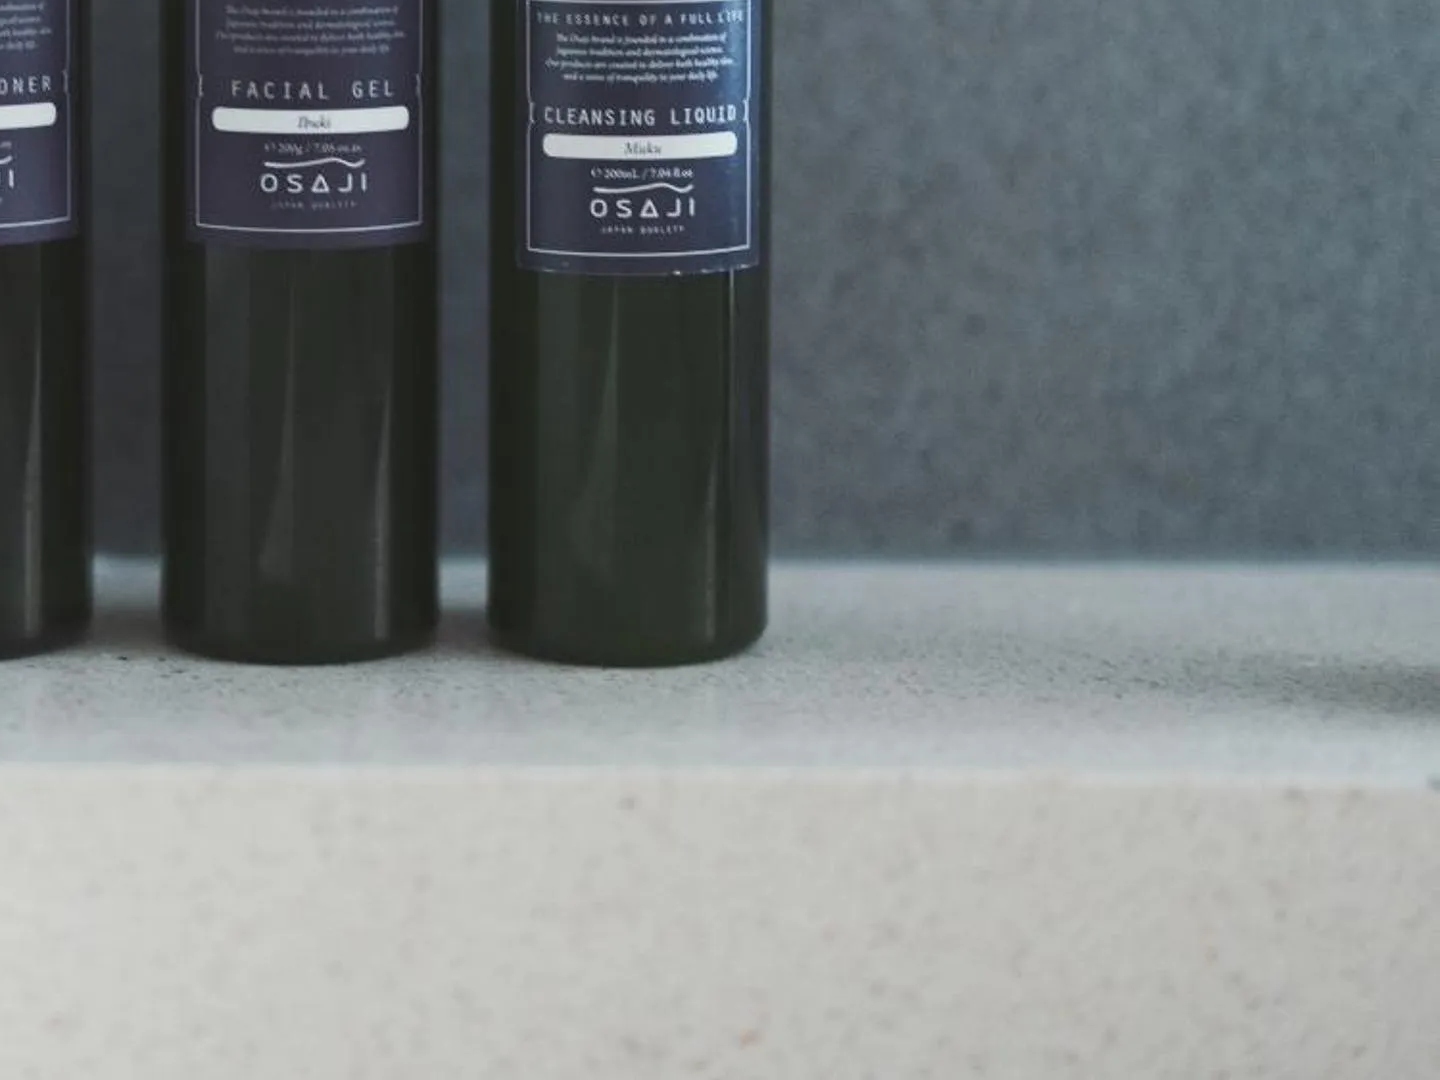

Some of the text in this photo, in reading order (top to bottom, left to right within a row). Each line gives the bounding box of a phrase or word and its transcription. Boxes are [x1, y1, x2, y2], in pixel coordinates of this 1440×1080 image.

[537, 12, 559, 24] THE
[566, 13, 628, 26] ESSENCE
[639, 13, 656, 26] OF
[664, 13, 673, 25] A
[680, 11, 713, 25] FULL
[231, 80, 394, 100] FACIAL GEL
[544, 104, 737, 126] CLEANSING LIQUID
[260, 172, 367, 193] OSAJI
[590, 197, 696, 218] OSAJI
